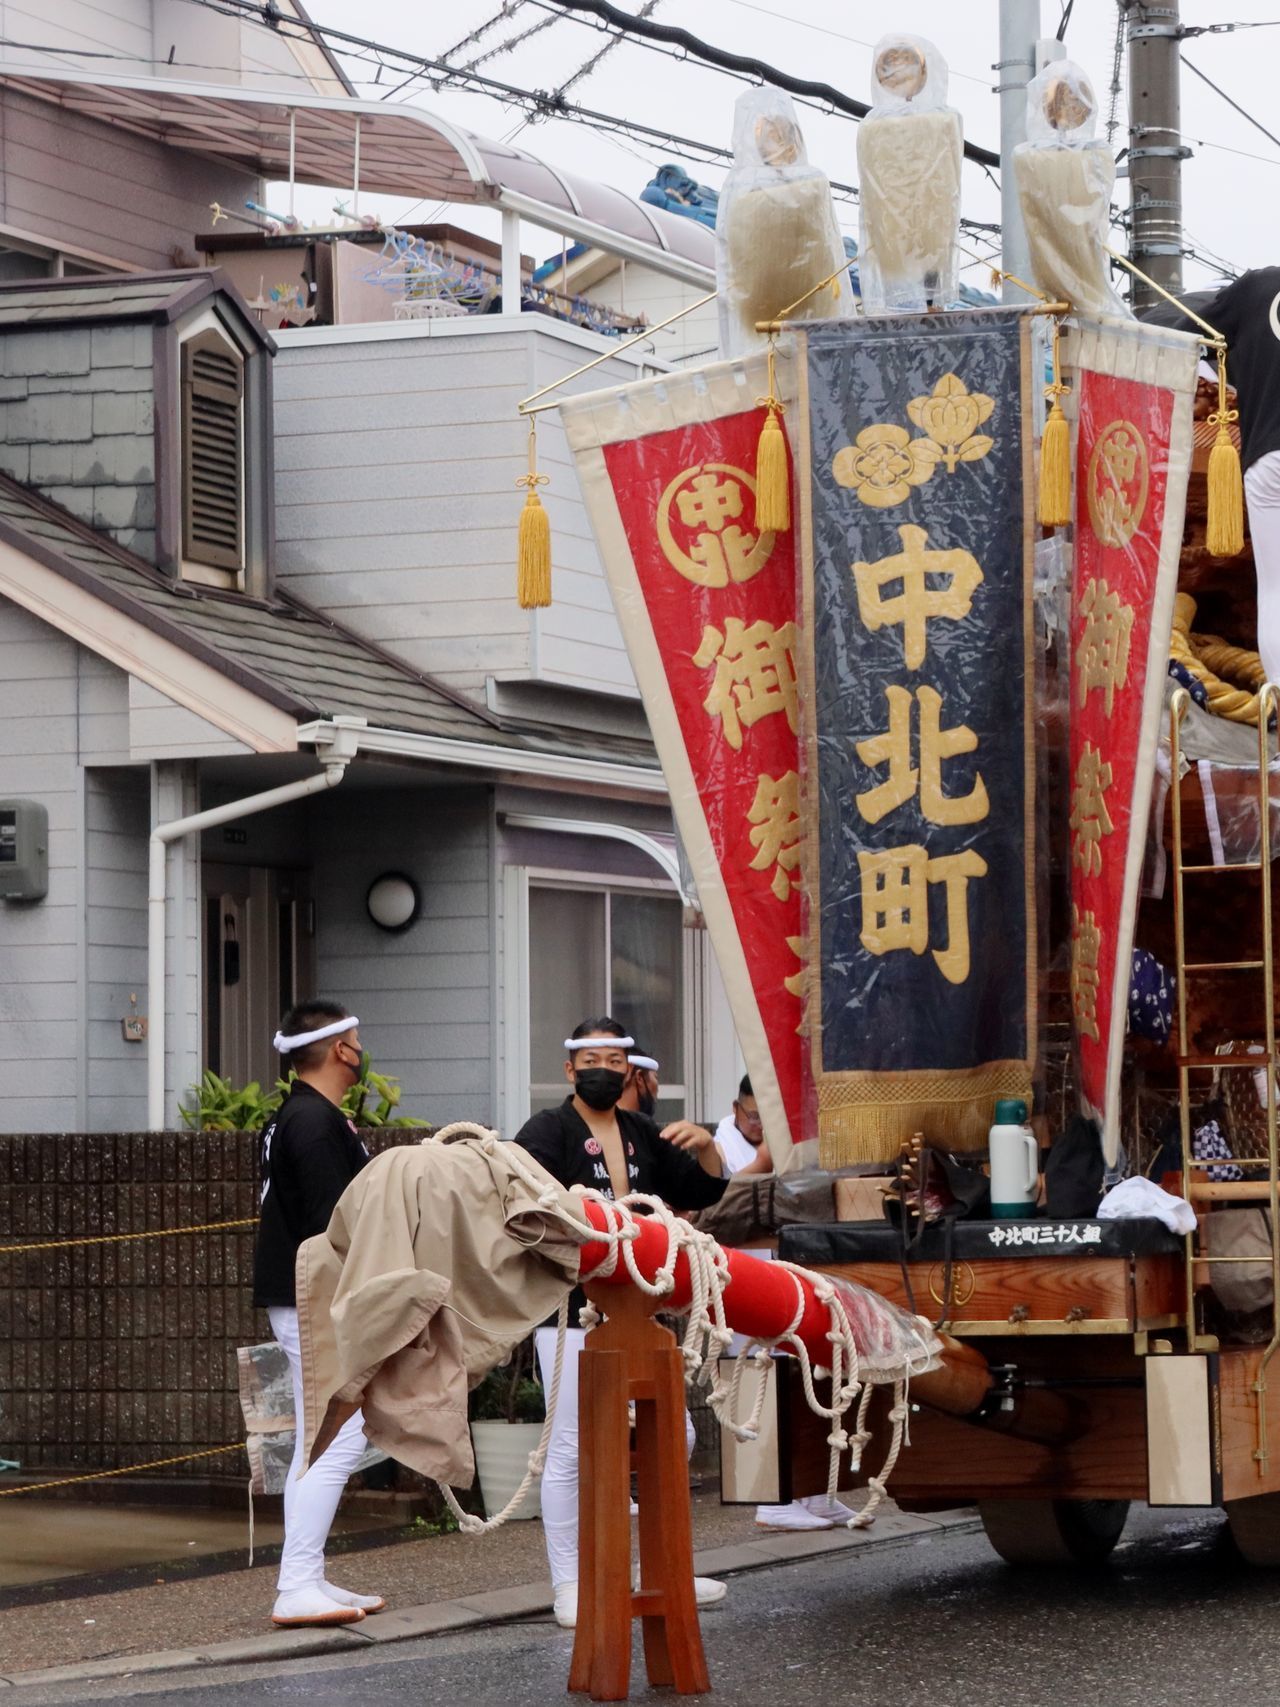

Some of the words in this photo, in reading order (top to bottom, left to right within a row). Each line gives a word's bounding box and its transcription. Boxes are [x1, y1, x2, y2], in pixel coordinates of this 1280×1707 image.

[851, 524, 989, 984] 中北町
[988, 1223, 1102, 1246] 中北町三十人組
